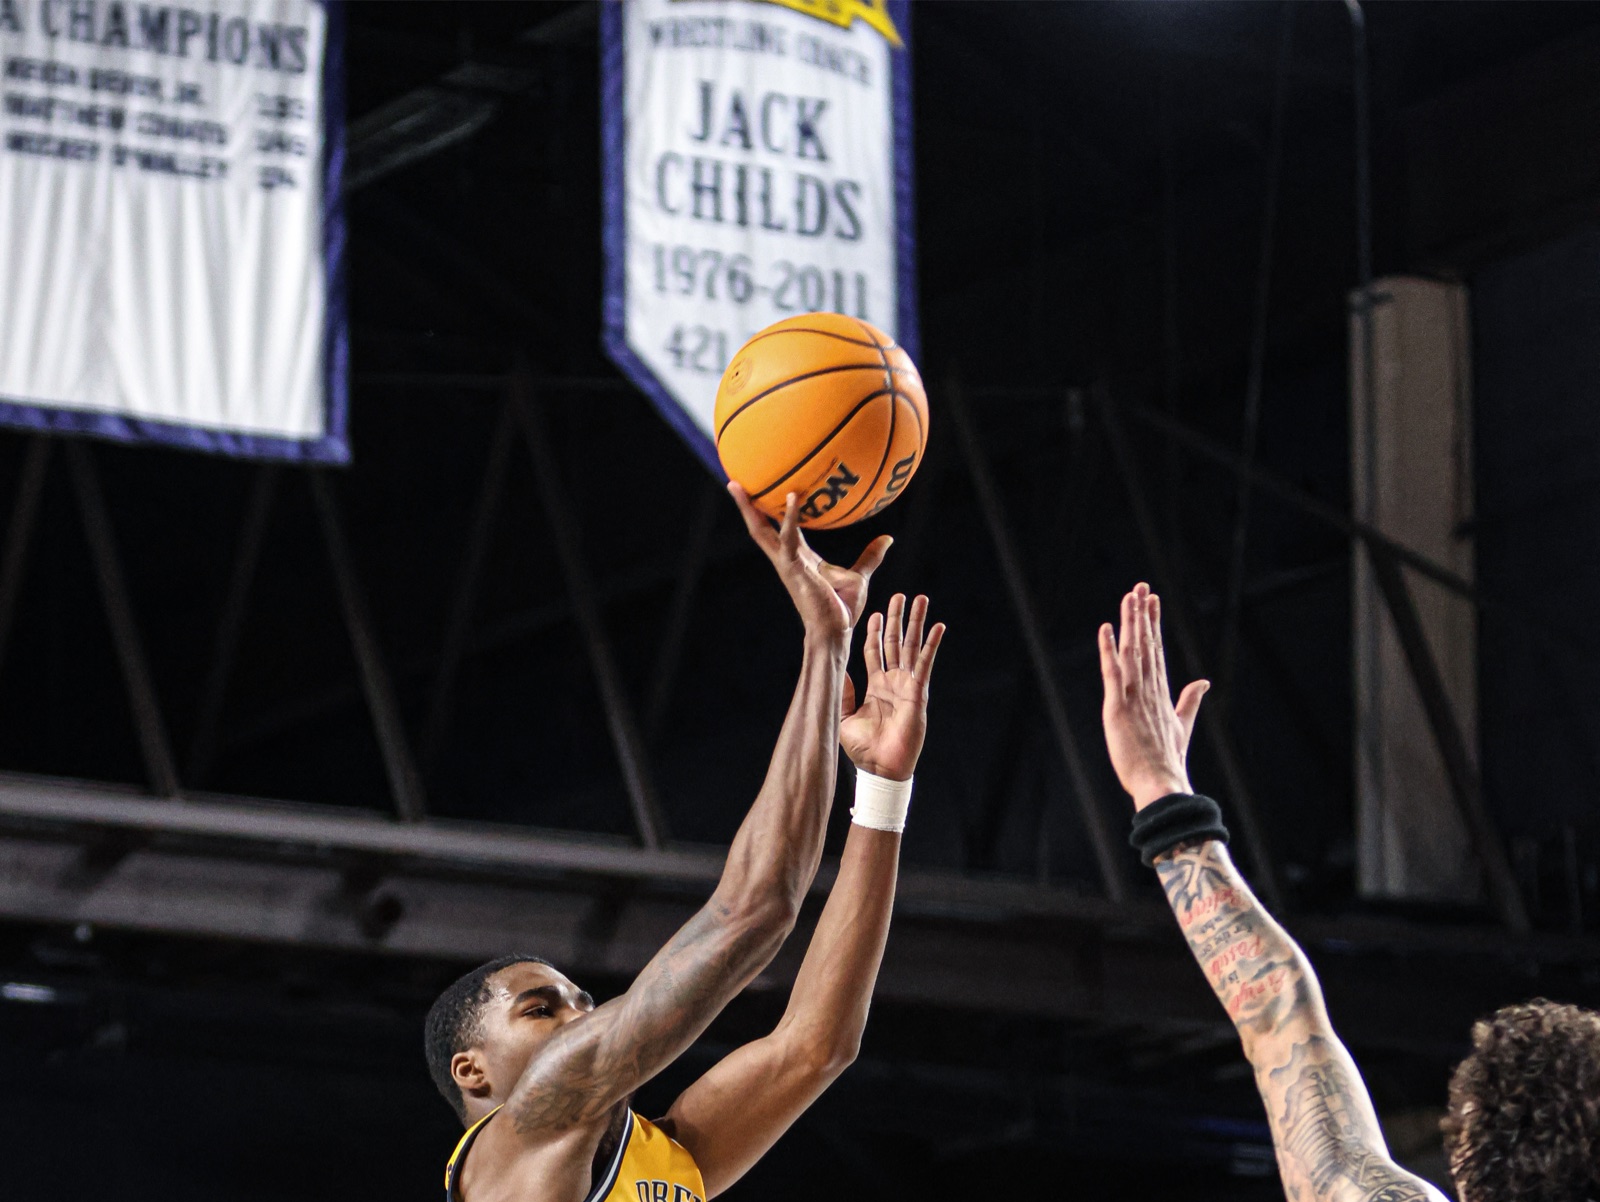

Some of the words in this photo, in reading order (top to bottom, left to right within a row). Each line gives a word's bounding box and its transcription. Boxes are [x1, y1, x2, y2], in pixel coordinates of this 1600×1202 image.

[40, 0, 308, 74] CHAMPIONS
[692, 78, 831, 163] JACK
[656, 150, 863, 242] CHILDS
[653, 243, 868, 320] 1976-2011
[664, 322, 728, 375] 421
